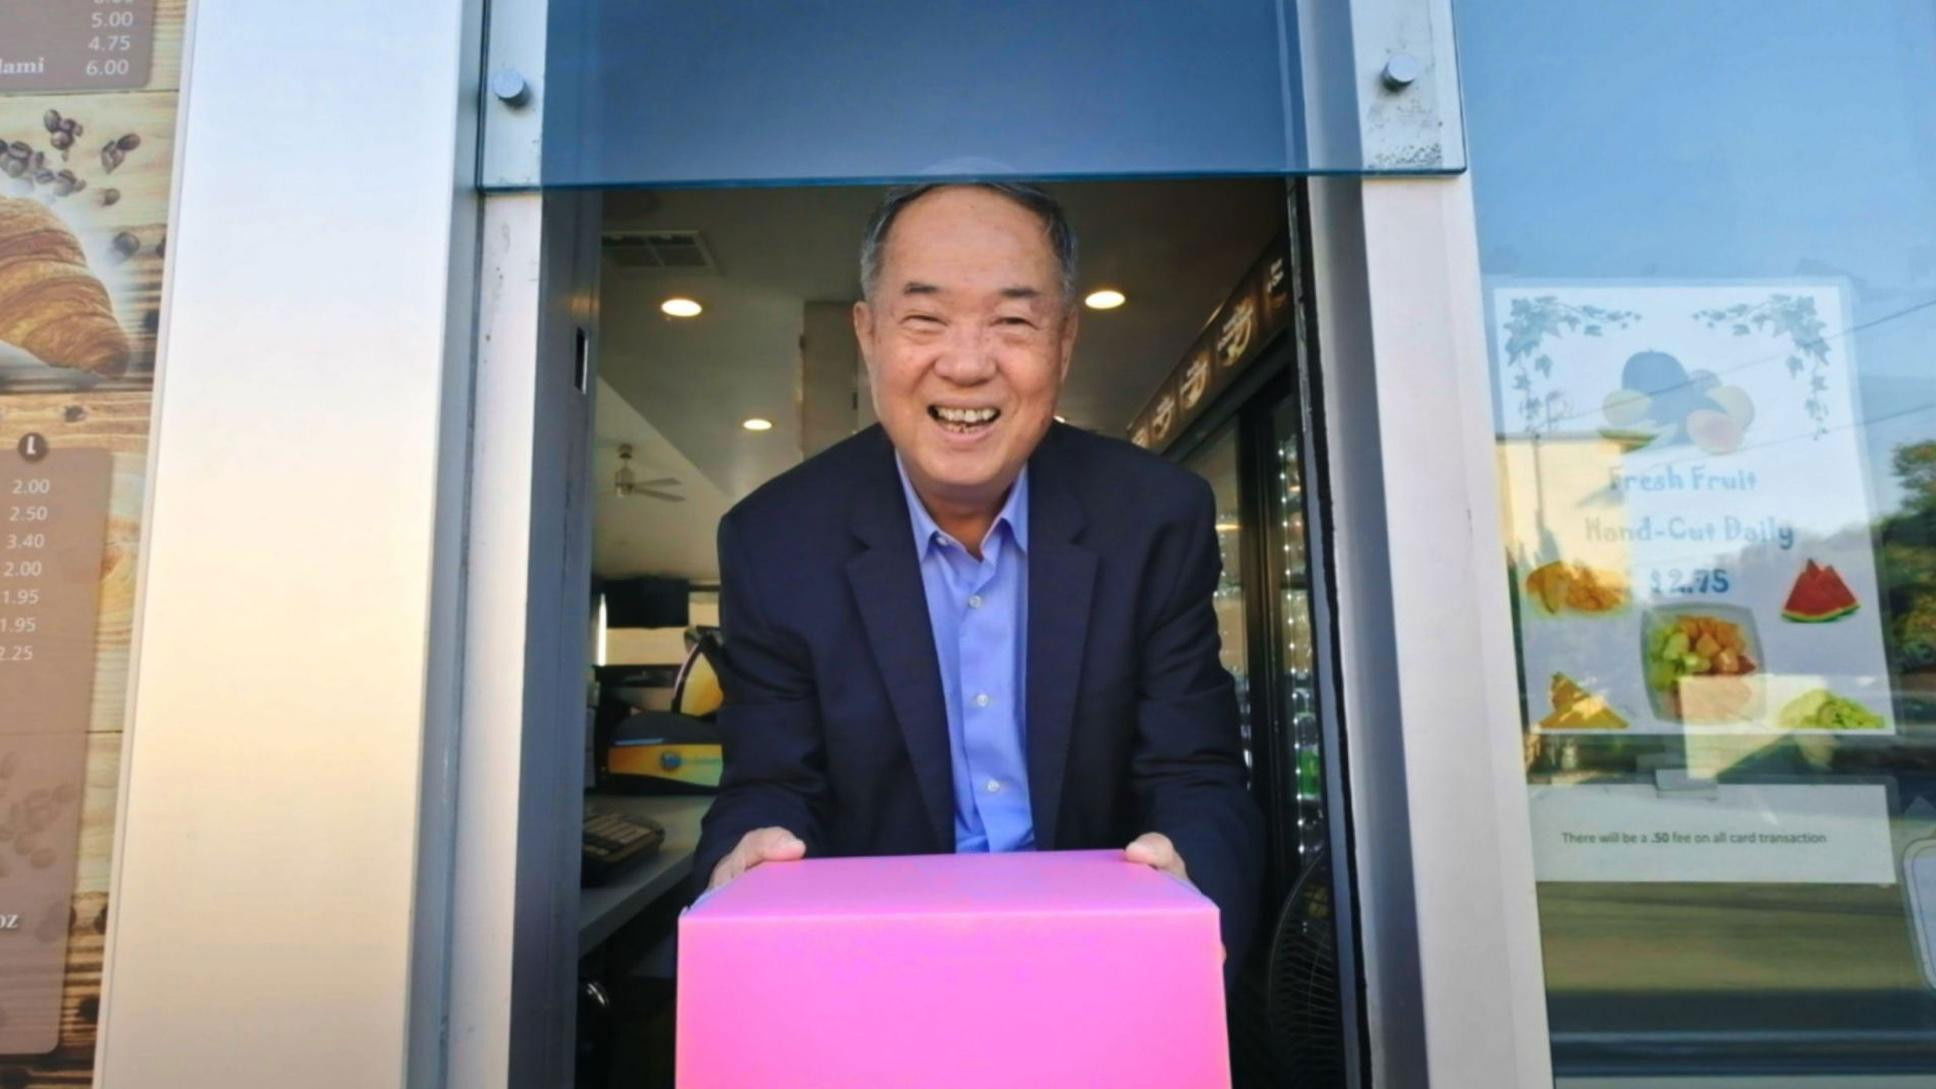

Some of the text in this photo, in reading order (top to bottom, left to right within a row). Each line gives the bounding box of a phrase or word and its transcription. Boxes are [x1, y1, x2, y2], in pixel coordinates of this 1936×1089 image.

[91, 11, 134, 28] 5.00
[88, 35, 131, 51] 4.75
[86, 59, 129, 76] 6.00
[1608, 465, 1757, 491] Fresh Fruit
[12, 479, 50, 494] 2.00
[9, 506, 48, 521] 2.50
[1585, 516, 1794, 549] Hand-Cut Daily
[7, 533, 45, 549] 3.40
[3, 561, 42, 577] 2.00
[1650, 568, 1729, 594] $2.75
[3, 589, 39, 605] 1.95
[1, 617, 36, 632] 1.95
[1561, 831, 1827, 844] There will be a .50 fee on all card transaction
